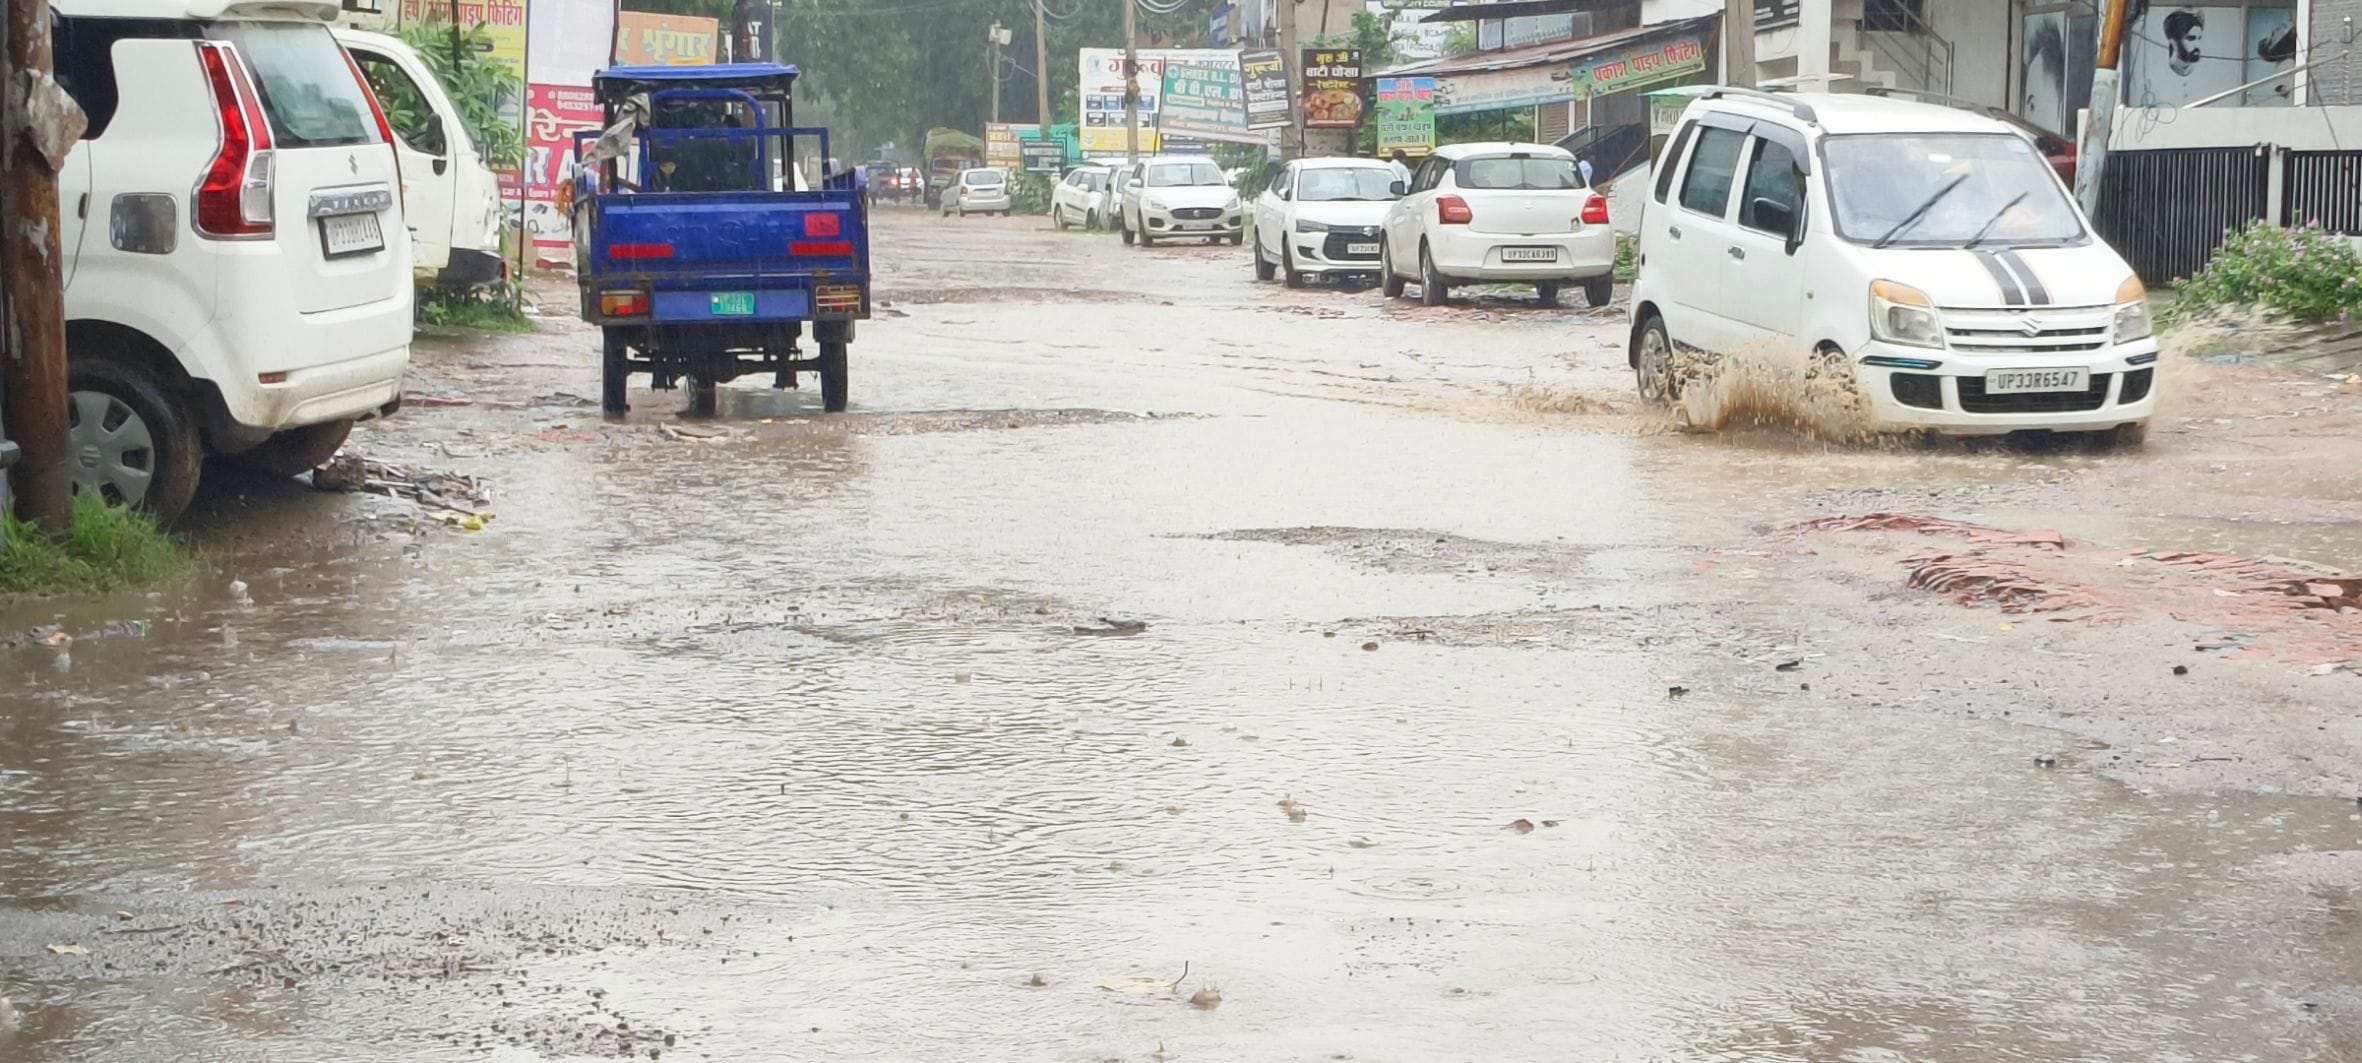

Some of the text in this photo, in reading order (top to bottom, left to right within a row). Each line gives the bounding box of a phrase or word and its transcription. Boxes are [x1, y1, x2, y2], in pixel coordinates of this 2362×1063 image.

[1306, 65, 1328, 77] बाटी
[1632, 52, 1662, 72] पाइप
[1997, 371, 2079, 389] UP33R6547
